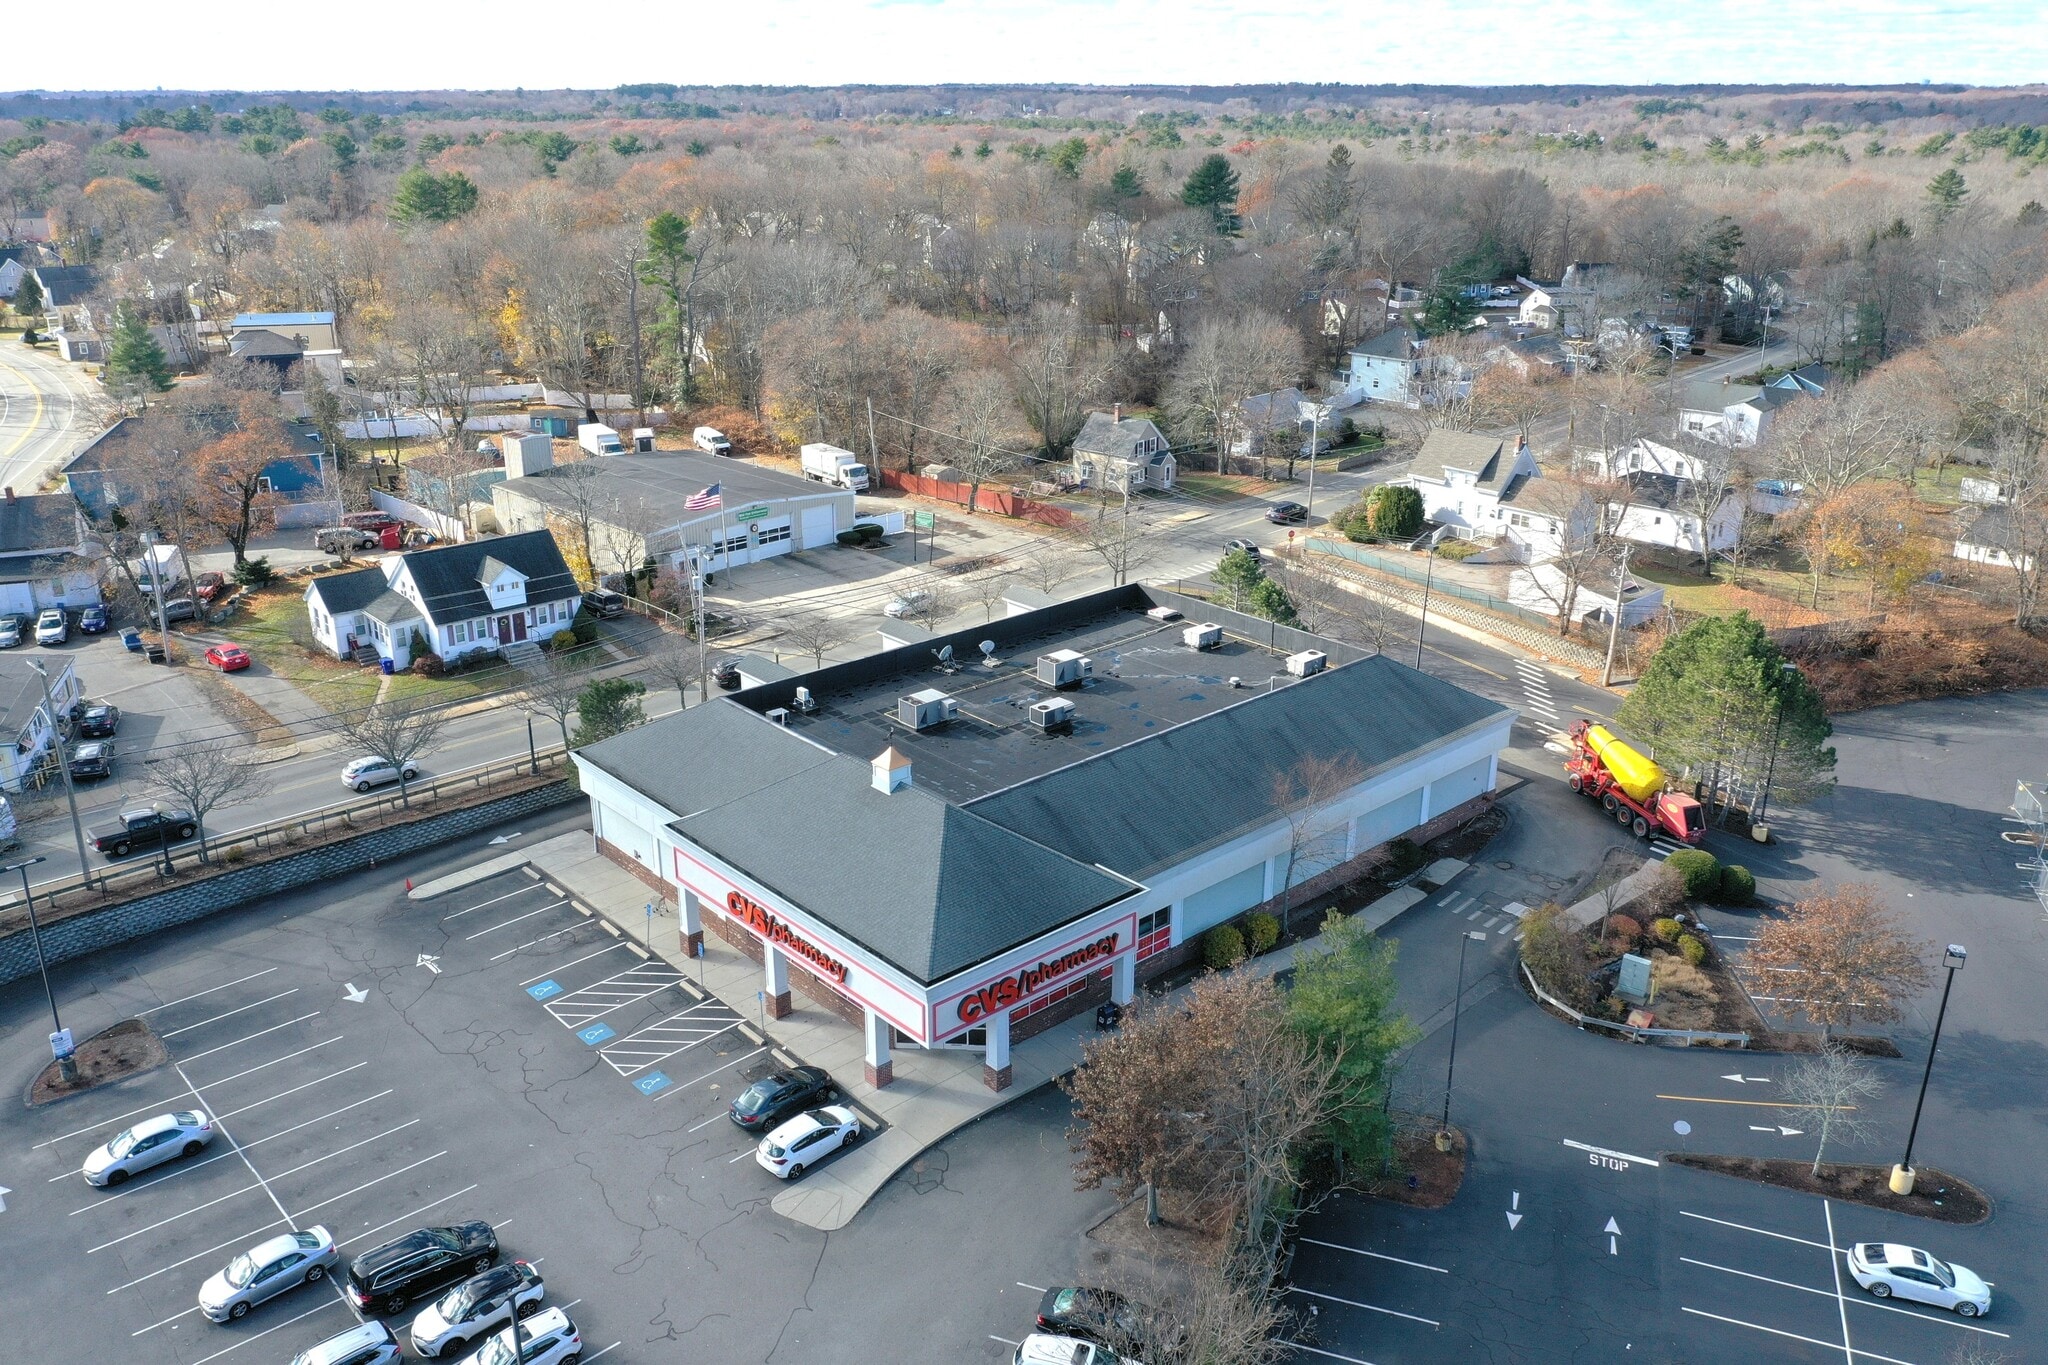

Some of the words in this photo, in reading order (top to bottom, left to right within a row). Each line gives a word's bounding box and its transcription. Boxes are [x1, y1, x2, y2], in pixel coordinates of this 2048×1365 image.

[727, 891, 848, 984] CVS/pharmacy
[958, 932, 1119, 1023] CVS/pharmacy
[1589, 1154, 1629, 1171] STOP
